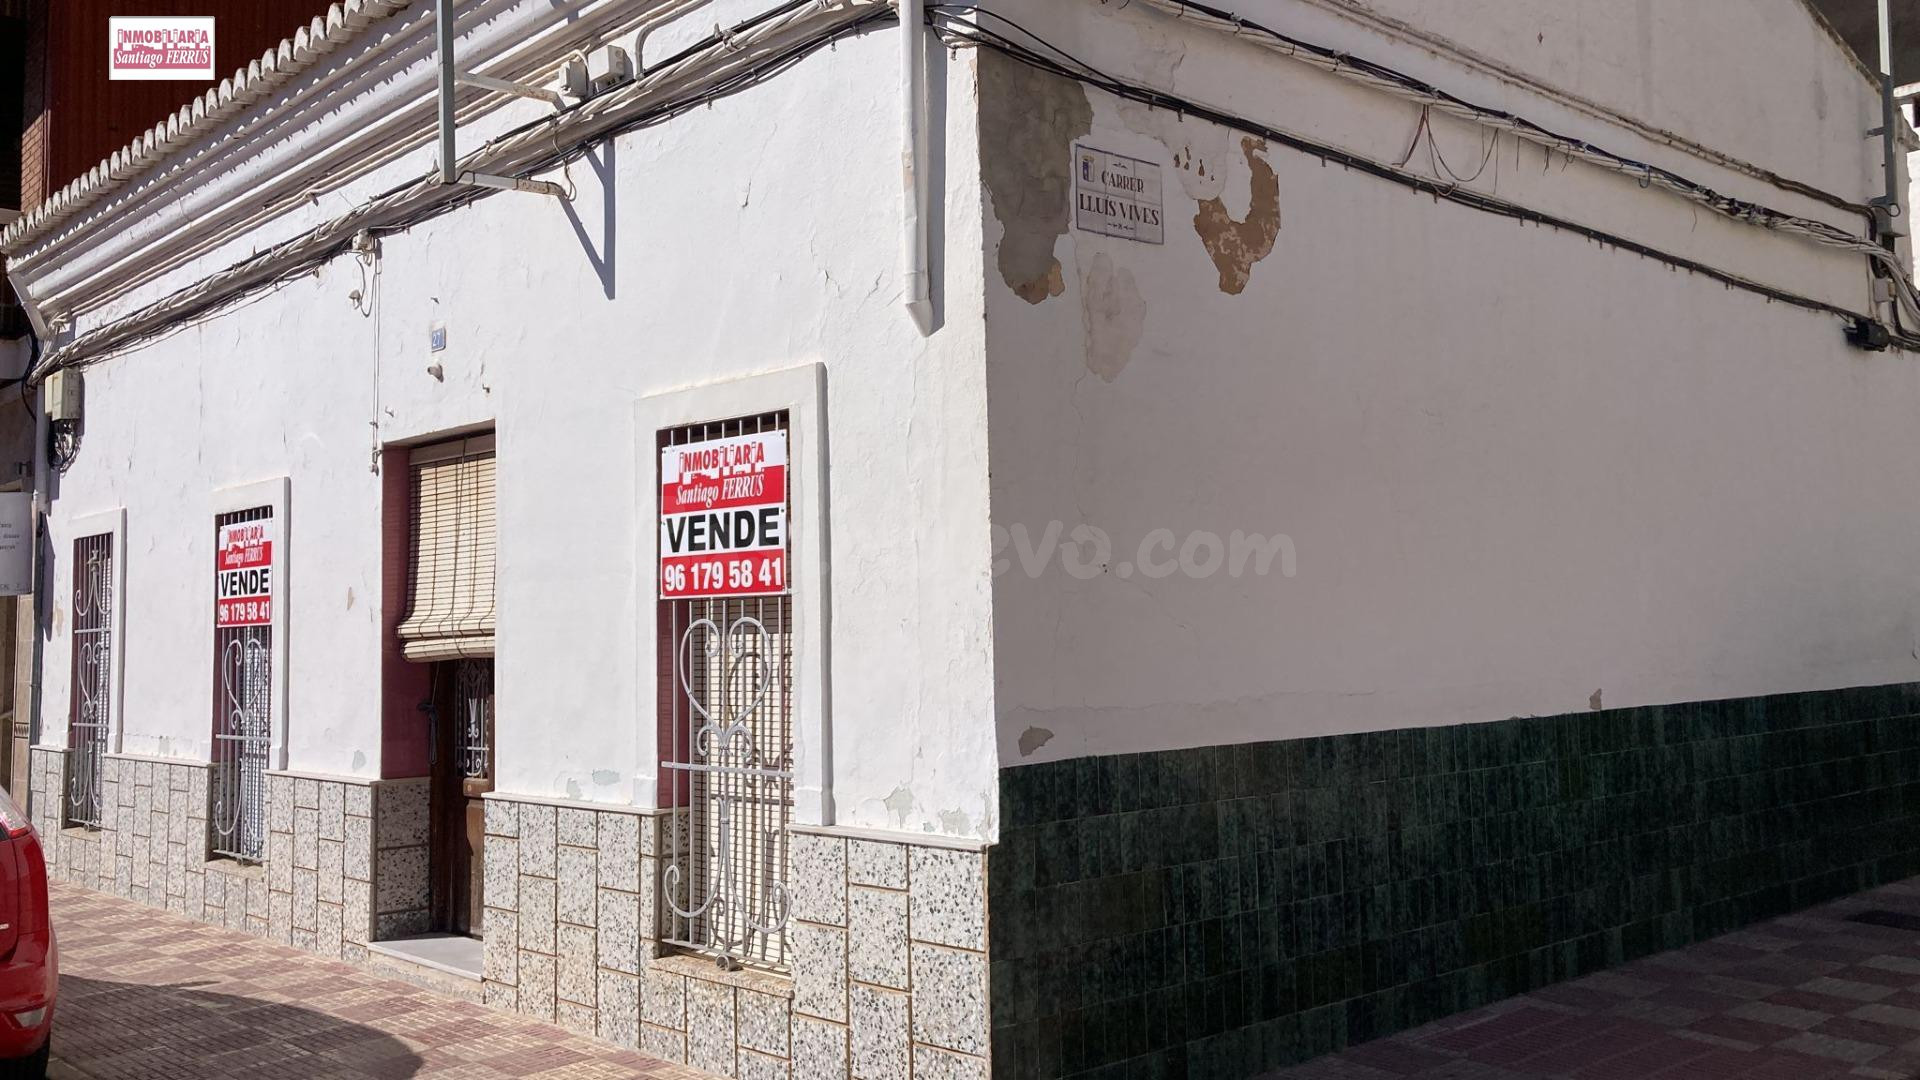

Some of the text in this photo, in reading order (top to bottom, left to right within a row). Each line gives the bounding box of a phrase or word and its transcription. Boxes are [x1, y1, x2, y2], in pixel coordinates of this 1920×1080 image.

[1101, 170, 1144, 193] CARRER
[1119, 202, 1159, 226] VIVES
[675, 484, 719, 508] Santiago
[666, 507, 780, 553] VENDE
[220, 568, 269, 597] VENDE
[664, 557, 782, 591] 96 179 58 41
[219, 600, 270, 622] 96 179 58 41
